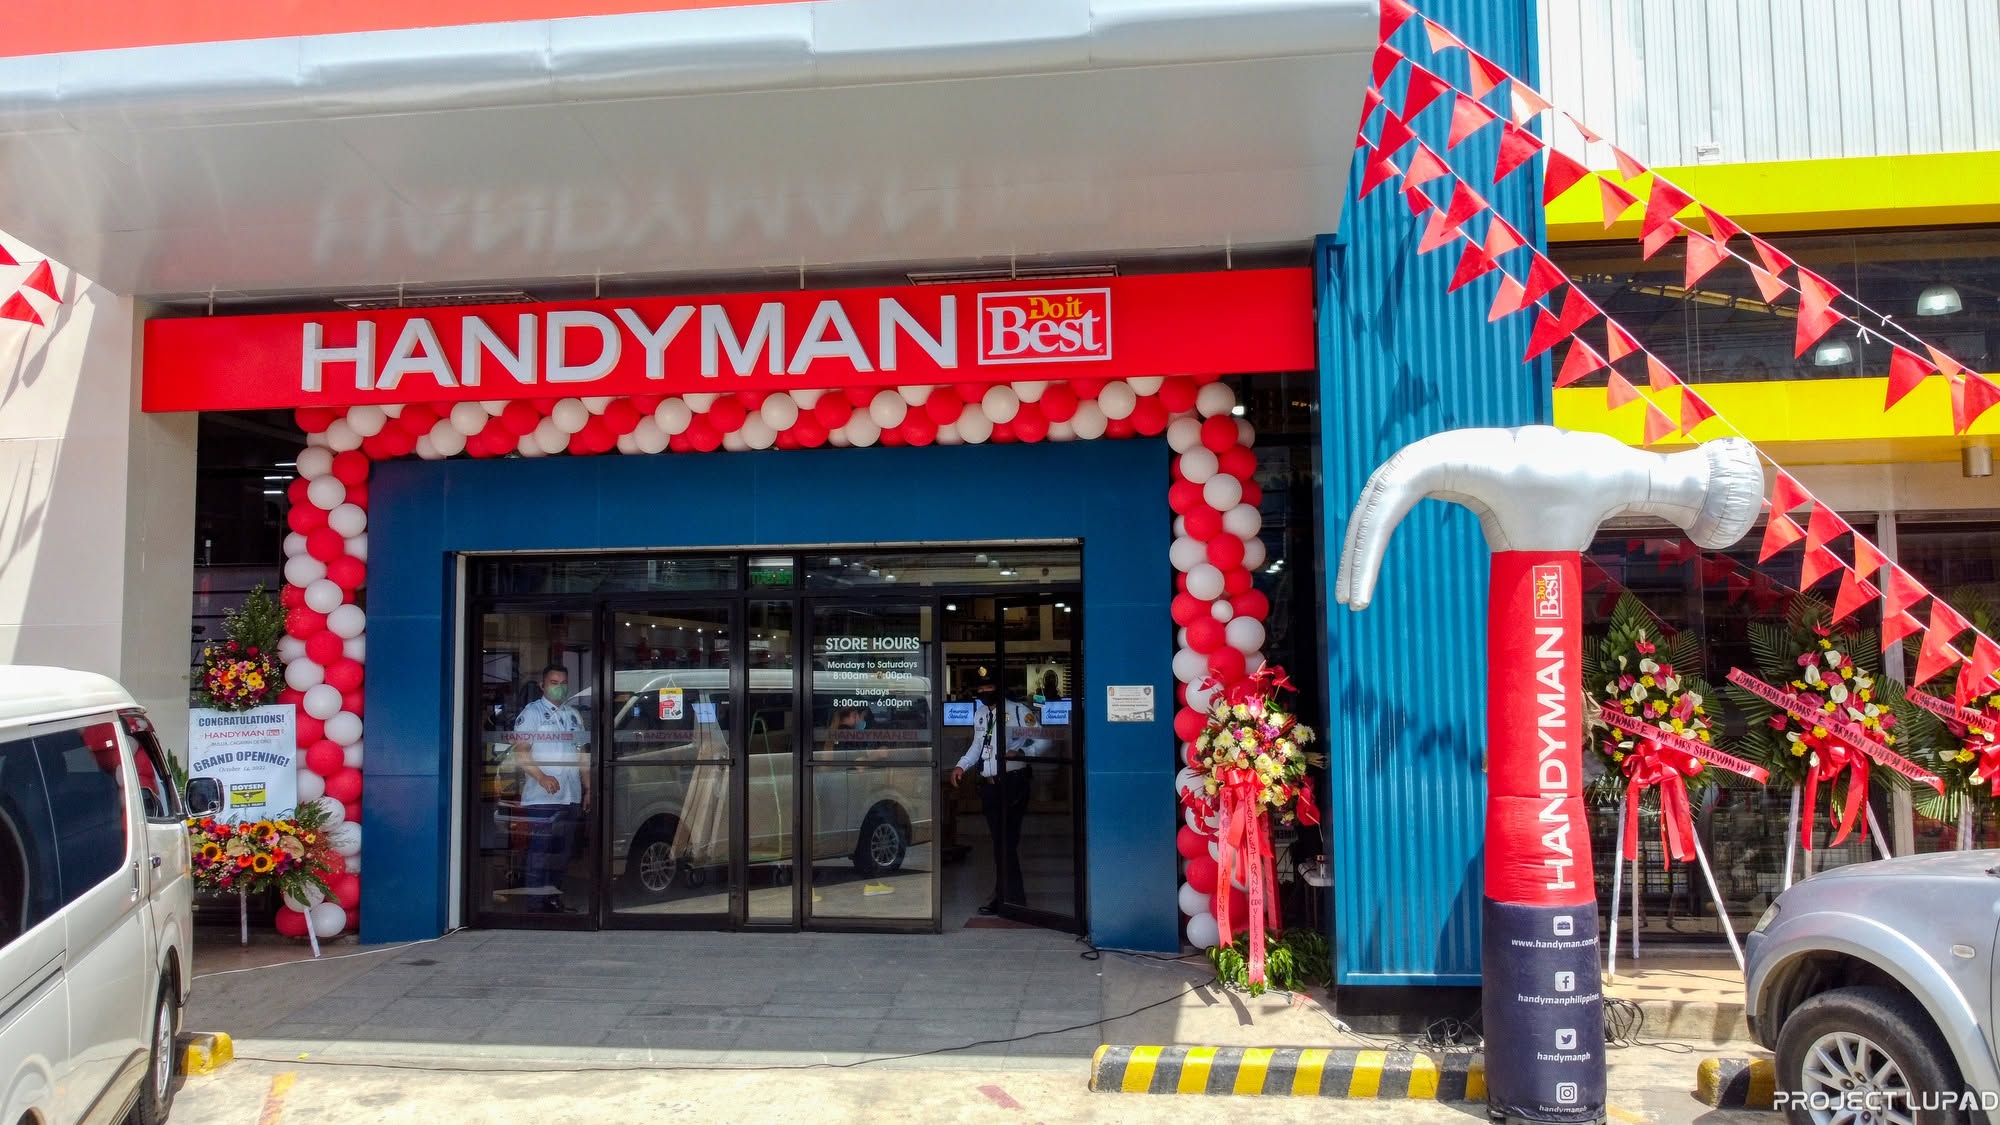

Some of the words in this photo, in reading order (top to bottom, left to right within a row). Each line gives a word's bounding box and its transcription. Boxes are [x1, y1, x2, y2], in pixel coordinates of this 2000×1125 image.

[986, 306, 1103, 356] Best
[301, 295, 959, 393] HANDYMAN
[1540, 571, 1559, 616] Best
[825, 637, 868, 650] STORE
[873, 637, 920, 650] HOURS
[827, 661, 865, 670] Mondays
[867, 661, 875, 669] to
[877, 661, 918, 670] Saturdays
[833, 671, 868, 680] 8:00am
[855, 687, 890, 696] Sundays
[833, 699, 868, 707] 8:00am
[876, 699, 913, 709] 6:00pm
[198, 714, 285, 727] CONGRATULATIONS!
[204, 730, 264, 739] HANDYMAN
[193, 752, 233, 772] GRAND
[236, 751, 290, 768] OPENING!
[1534, 627, 1576, 889] HANDYMAN
[1517, 993, 1600, 1007] handymanphilippines
[1536, 1052, 1591, 1063] handymanph
